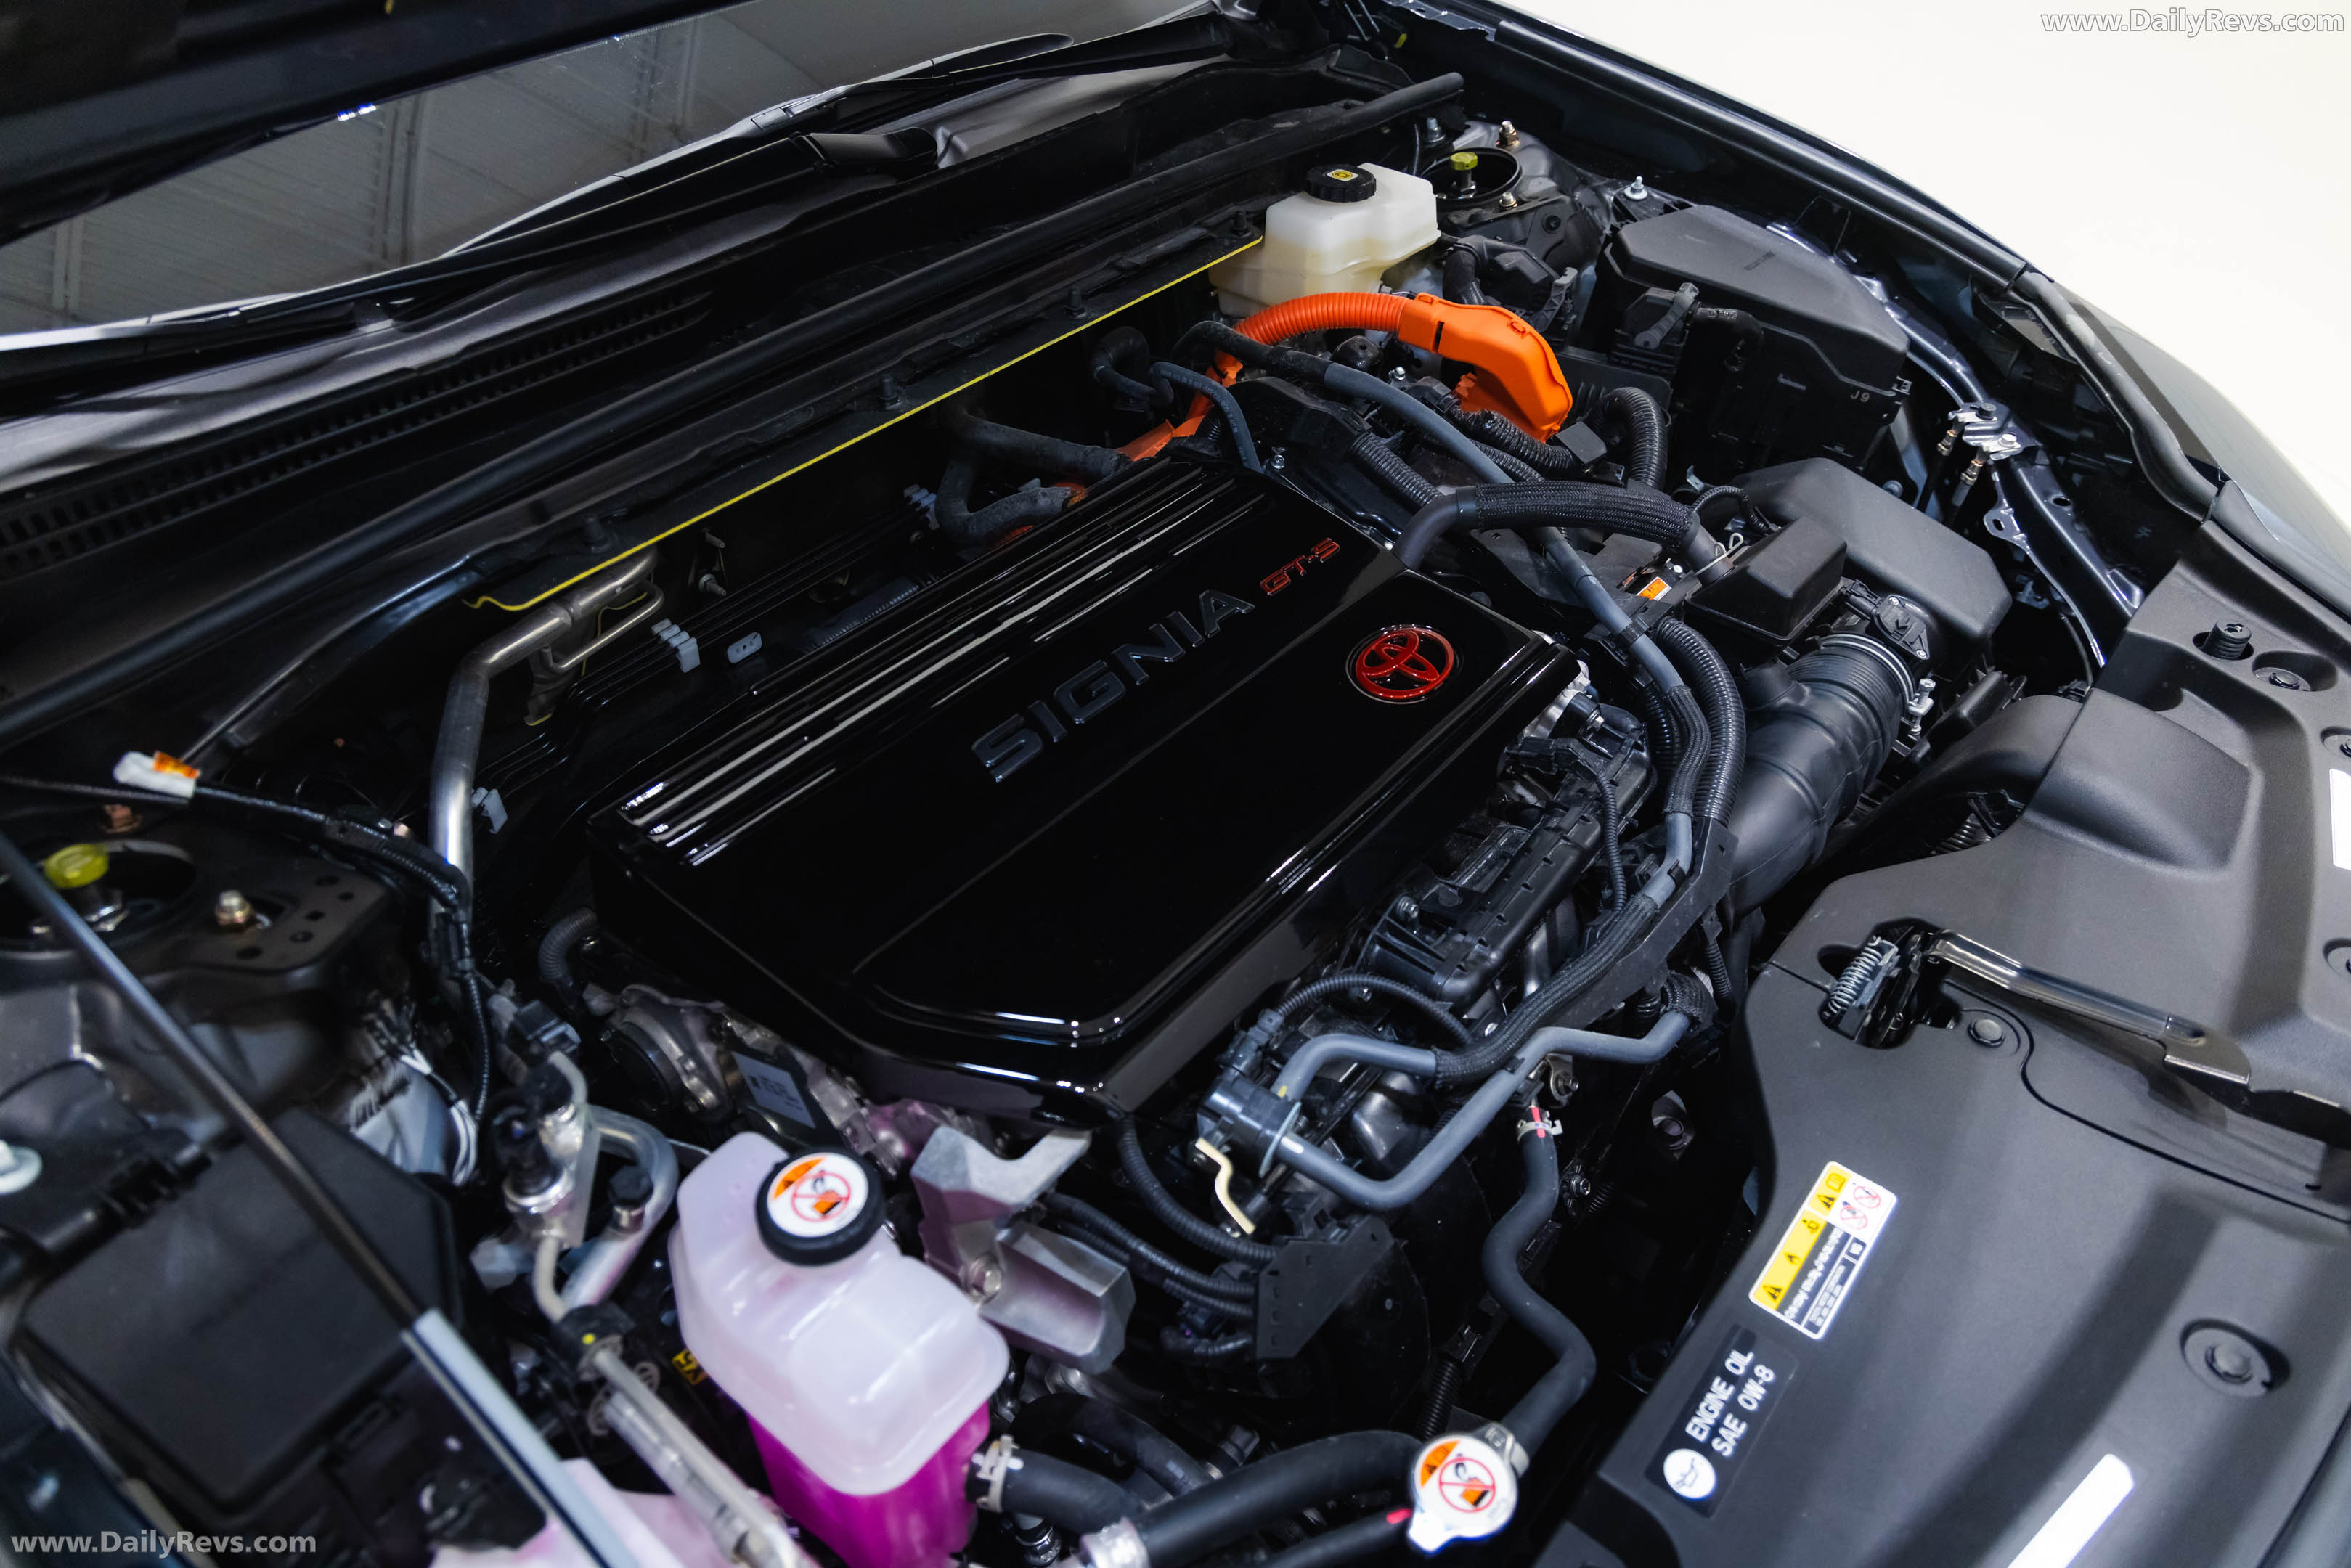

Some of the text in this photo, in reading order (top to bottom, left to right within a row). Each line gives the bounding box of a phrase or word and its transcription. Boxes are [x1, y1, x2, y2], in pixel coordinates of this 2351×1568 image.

[971, 589, 1255, 782] SIGNIA
[1685, 1349, 1753, 1442] ENGINE OIL
[1711, 1413, 1748, 1457] SAE
